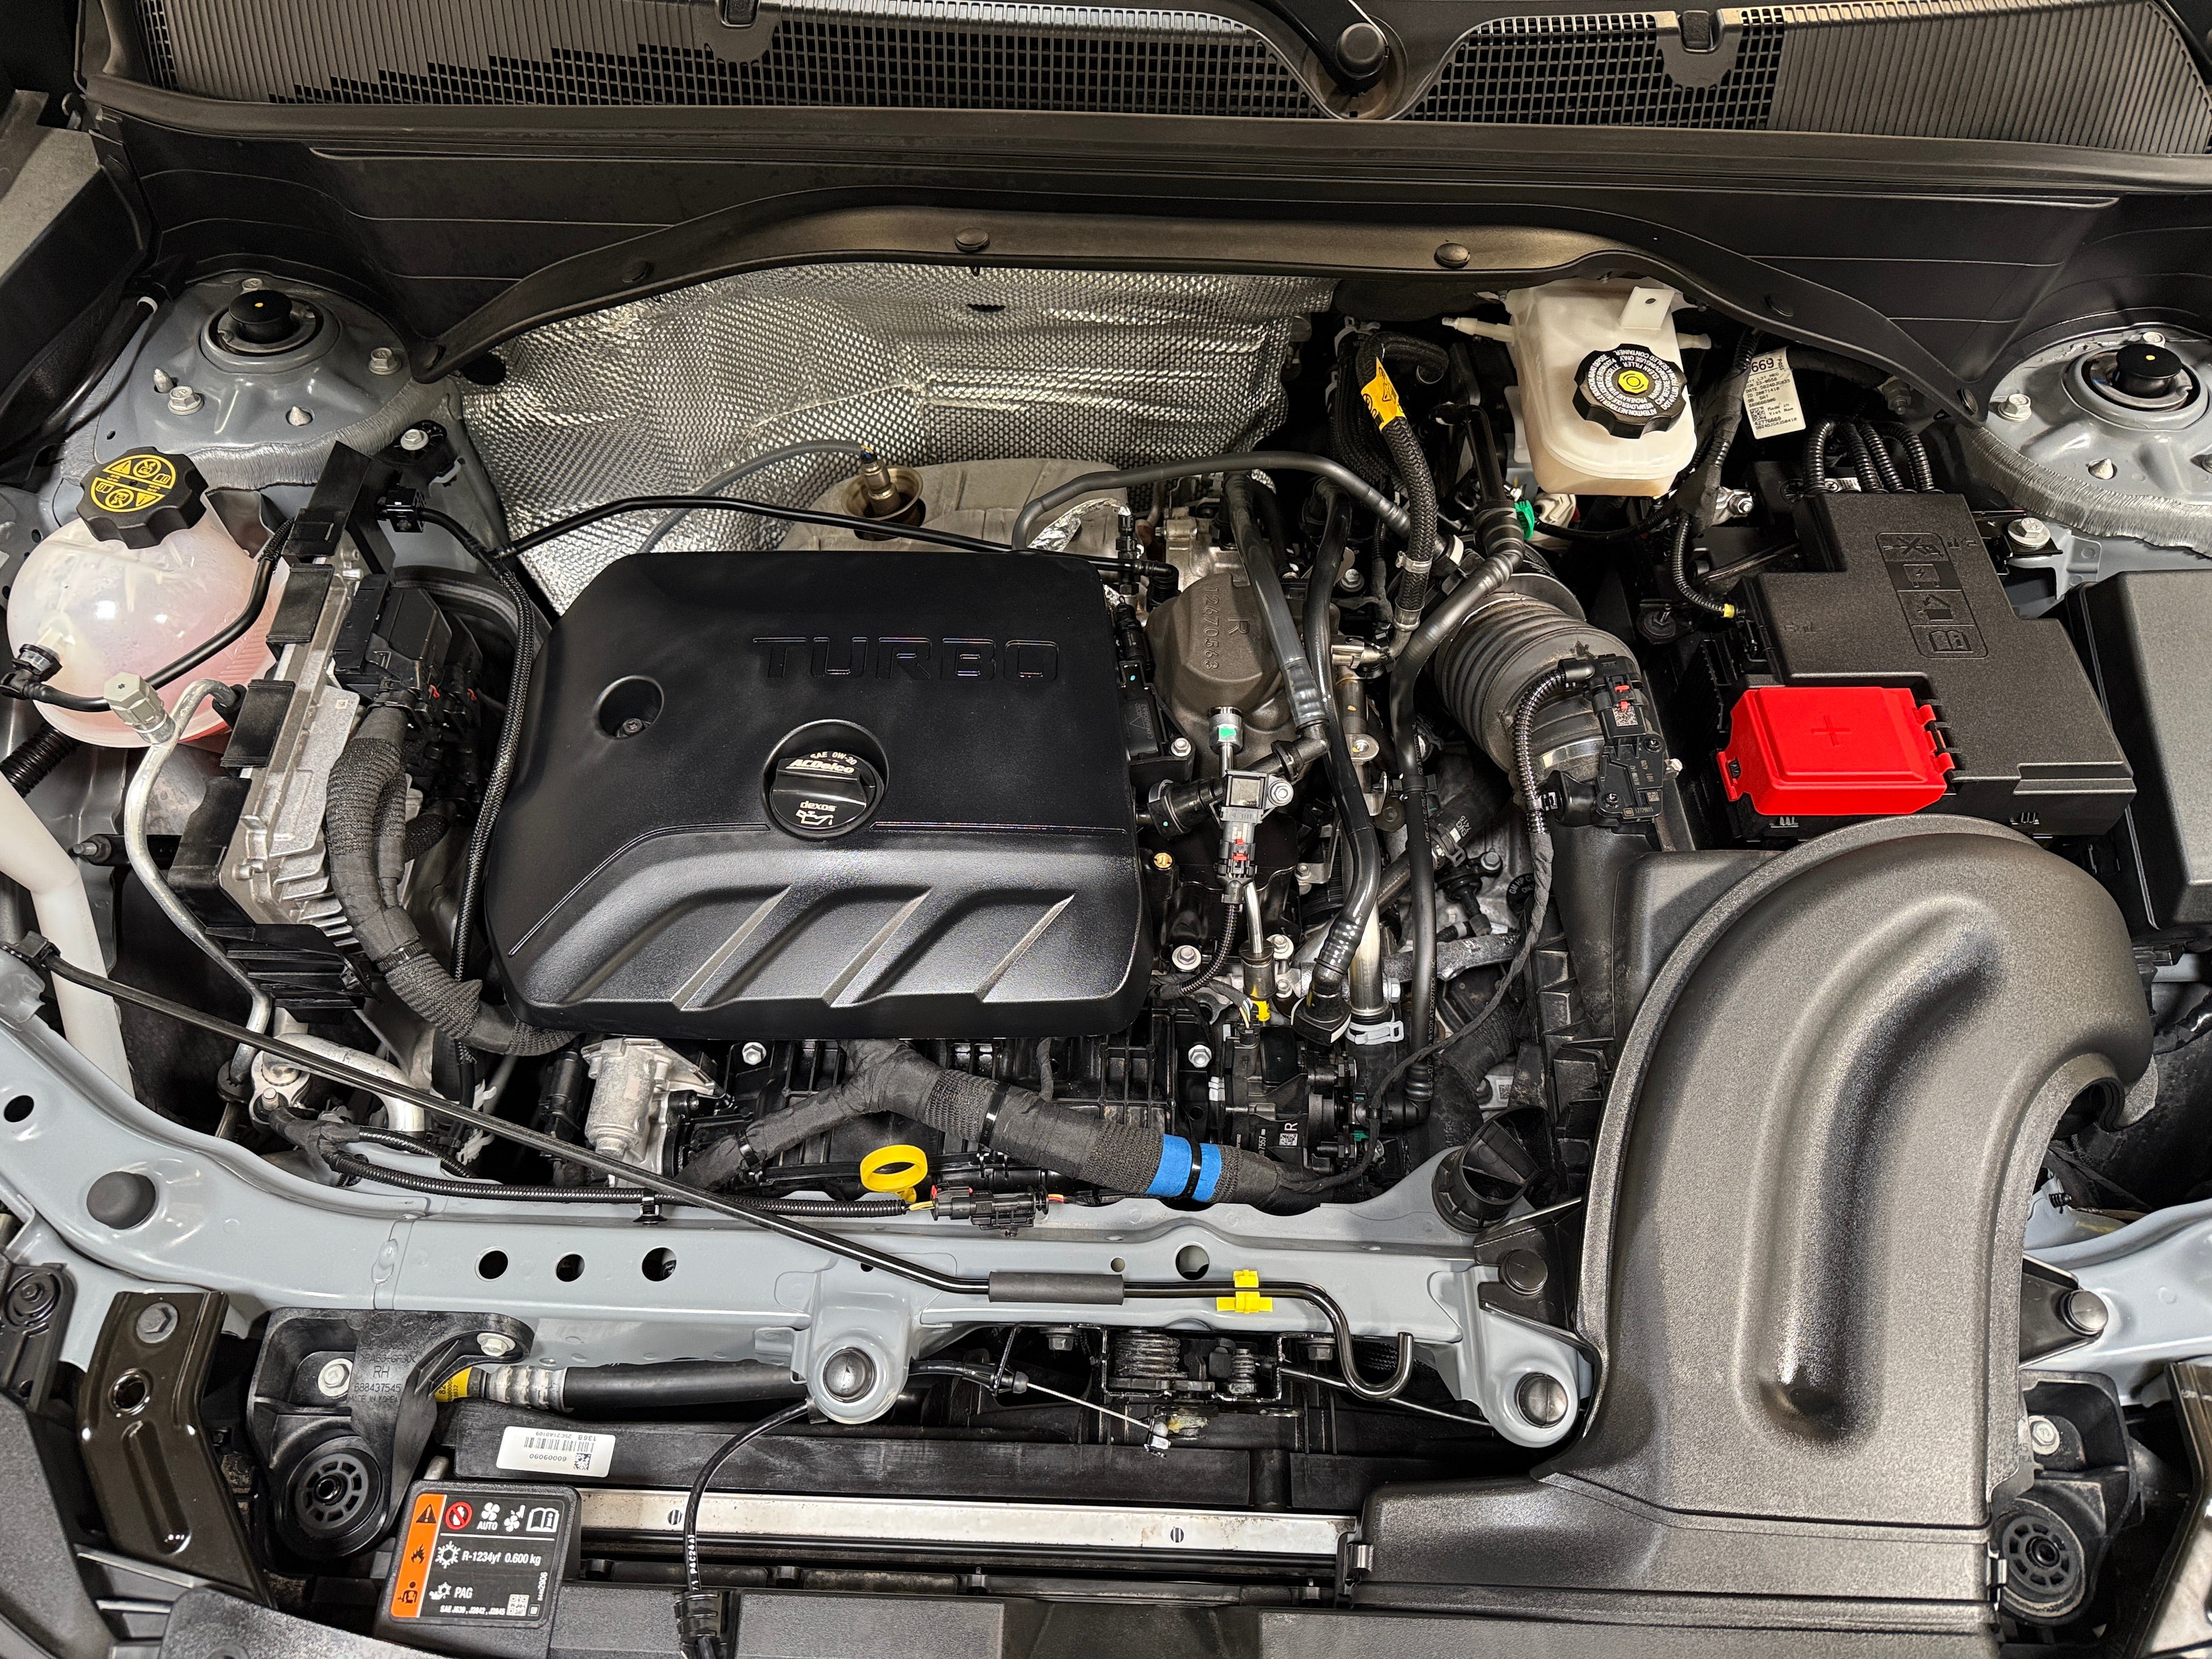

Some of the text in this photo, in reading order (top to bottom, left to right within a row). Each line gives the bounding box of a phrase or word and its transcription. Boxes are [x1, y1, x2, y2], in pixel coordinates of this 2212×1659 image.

[1202, 586, 1220, 671] 12670563
[752, 636, 1059, 680] TURBO
[810, 751, 858, 766] SAE 0W-20
[789, 759, 855, 774] ACDelco
[800, 800, 837, 812] dexos
[1455, 821, 1469, 837] ENG
[1460, 815, 1472, 832] 7415
[1509, 883, 1519, 895] GM
[1515, 877, 1525, 887] HP
[1431, 958, 1436, 968] NC
[1284, 1122, 1299, 1131] R
[373, 1365, 390, 1379] RH
[354, 1383, 402, 1392] 688437545
[529, 1453, 567, 1462] 60009090
[477, 1521, 498, 1531] AUTO
[461, 1550, 542, 1566] R-1234yf 0.600 kg
[454, 1587, 473, 1599] PAG
[440, 1605, 453, 1613] SAE
